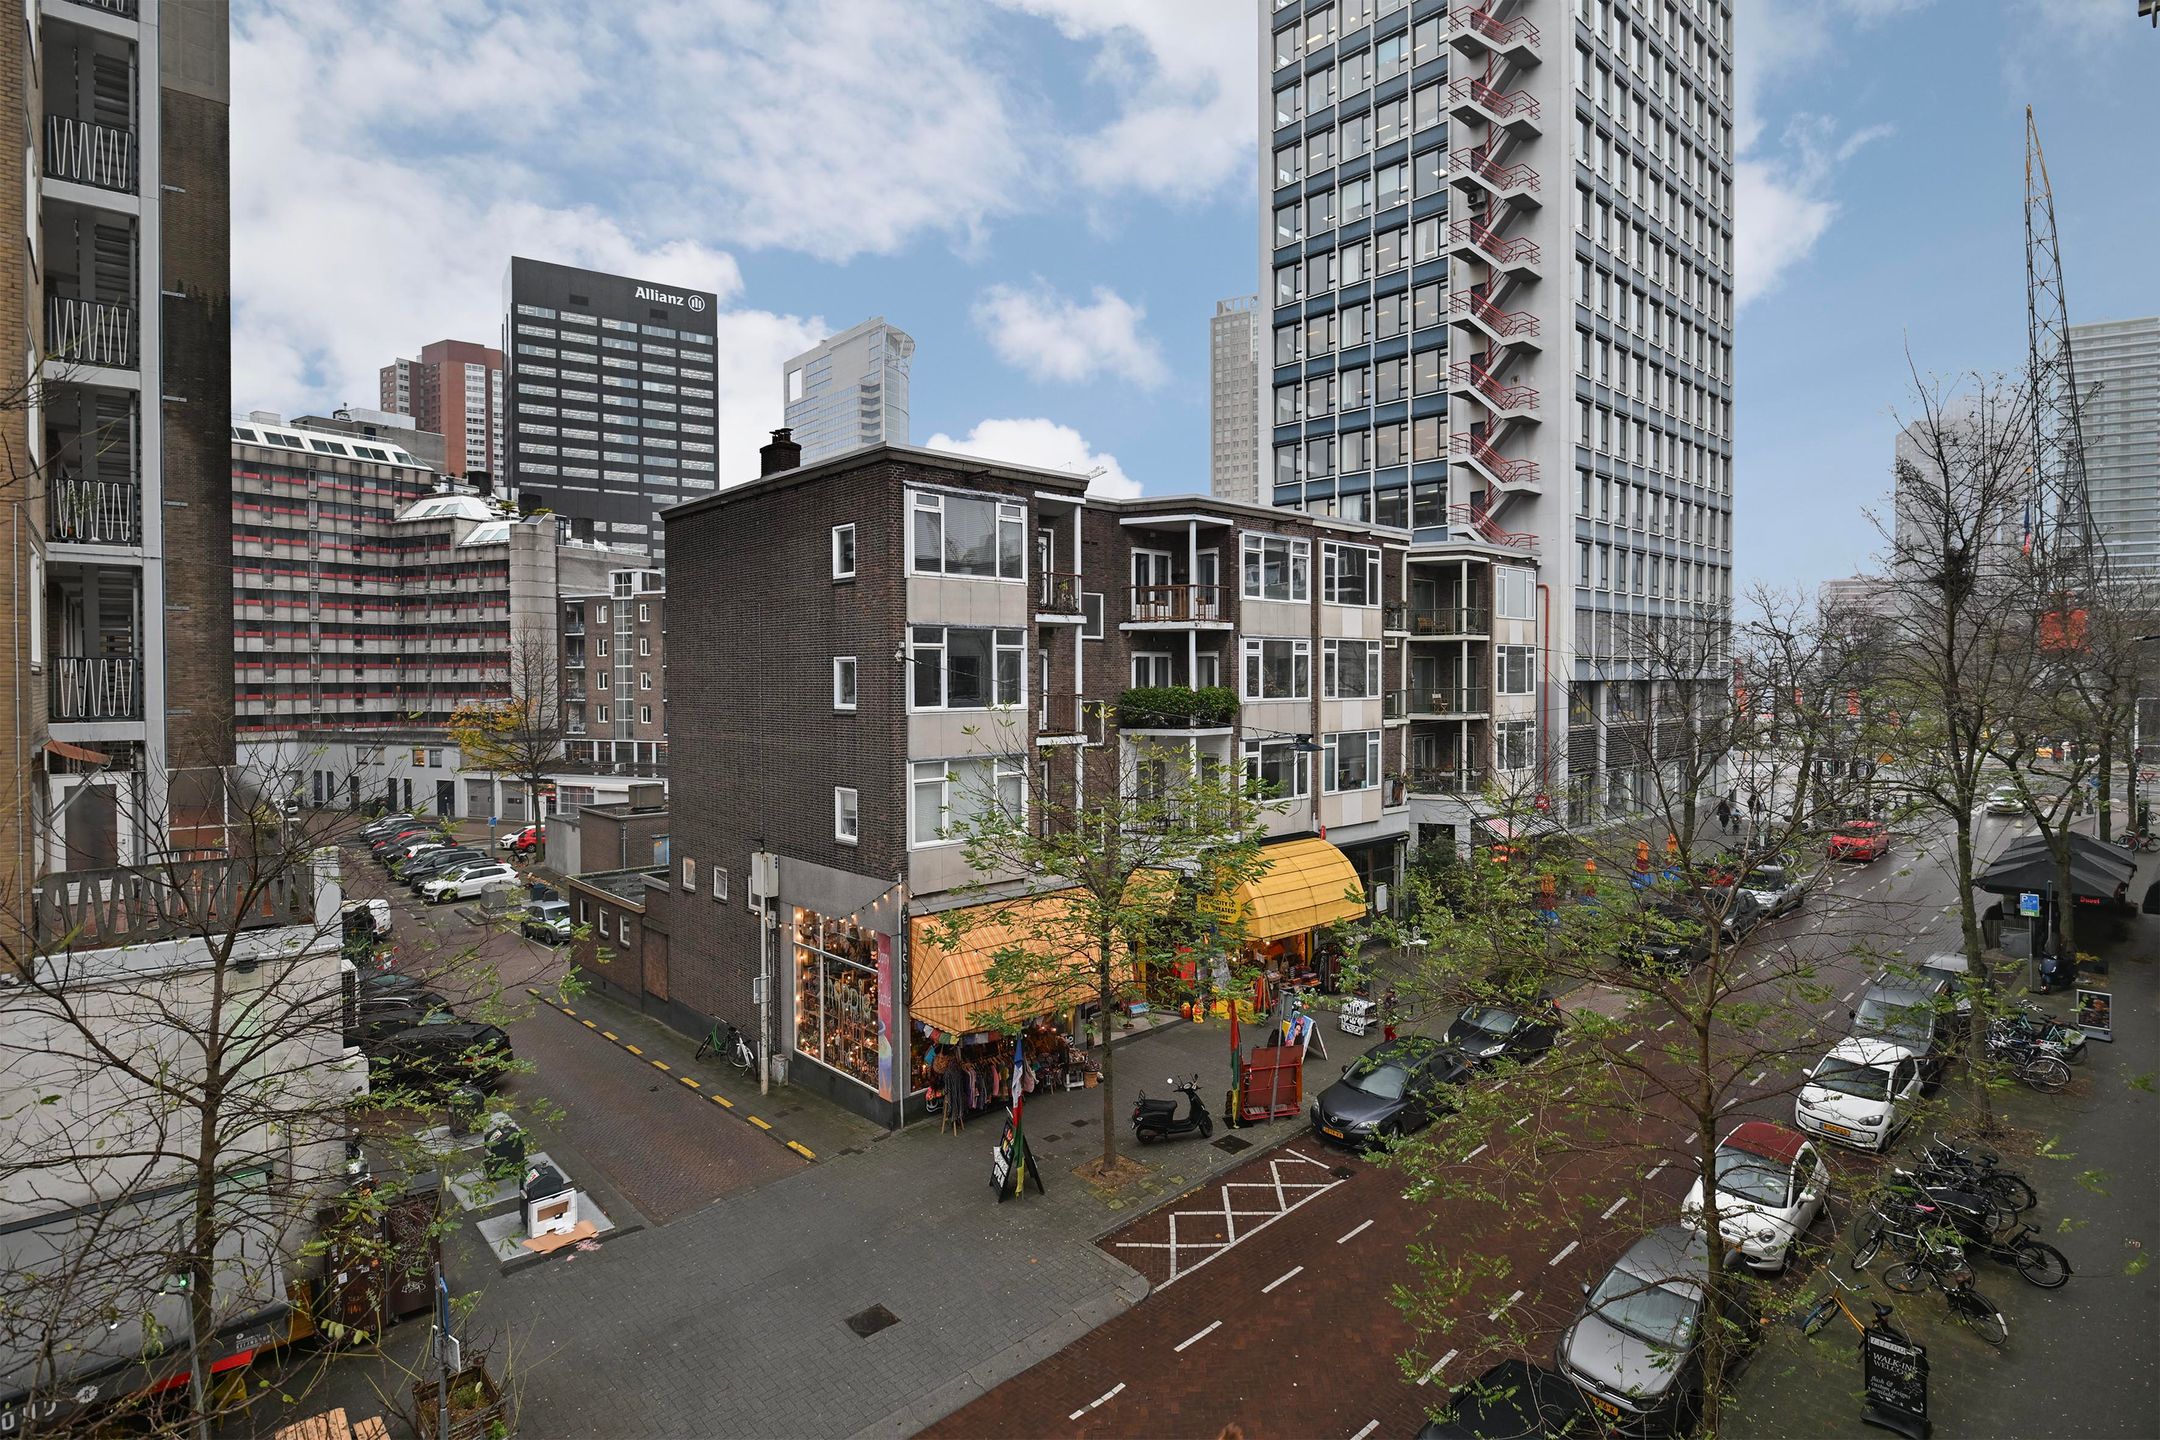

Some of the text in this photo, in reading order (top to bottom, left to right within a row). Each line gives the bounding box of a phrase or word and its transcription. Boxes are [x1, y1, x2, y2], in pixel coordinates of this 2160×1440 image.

[635, 286, 684, 306] Allianz
[1873, 1352, 1918, 1374] WALK-INS
[1873, 1359, 1915, 1380] WELCO
